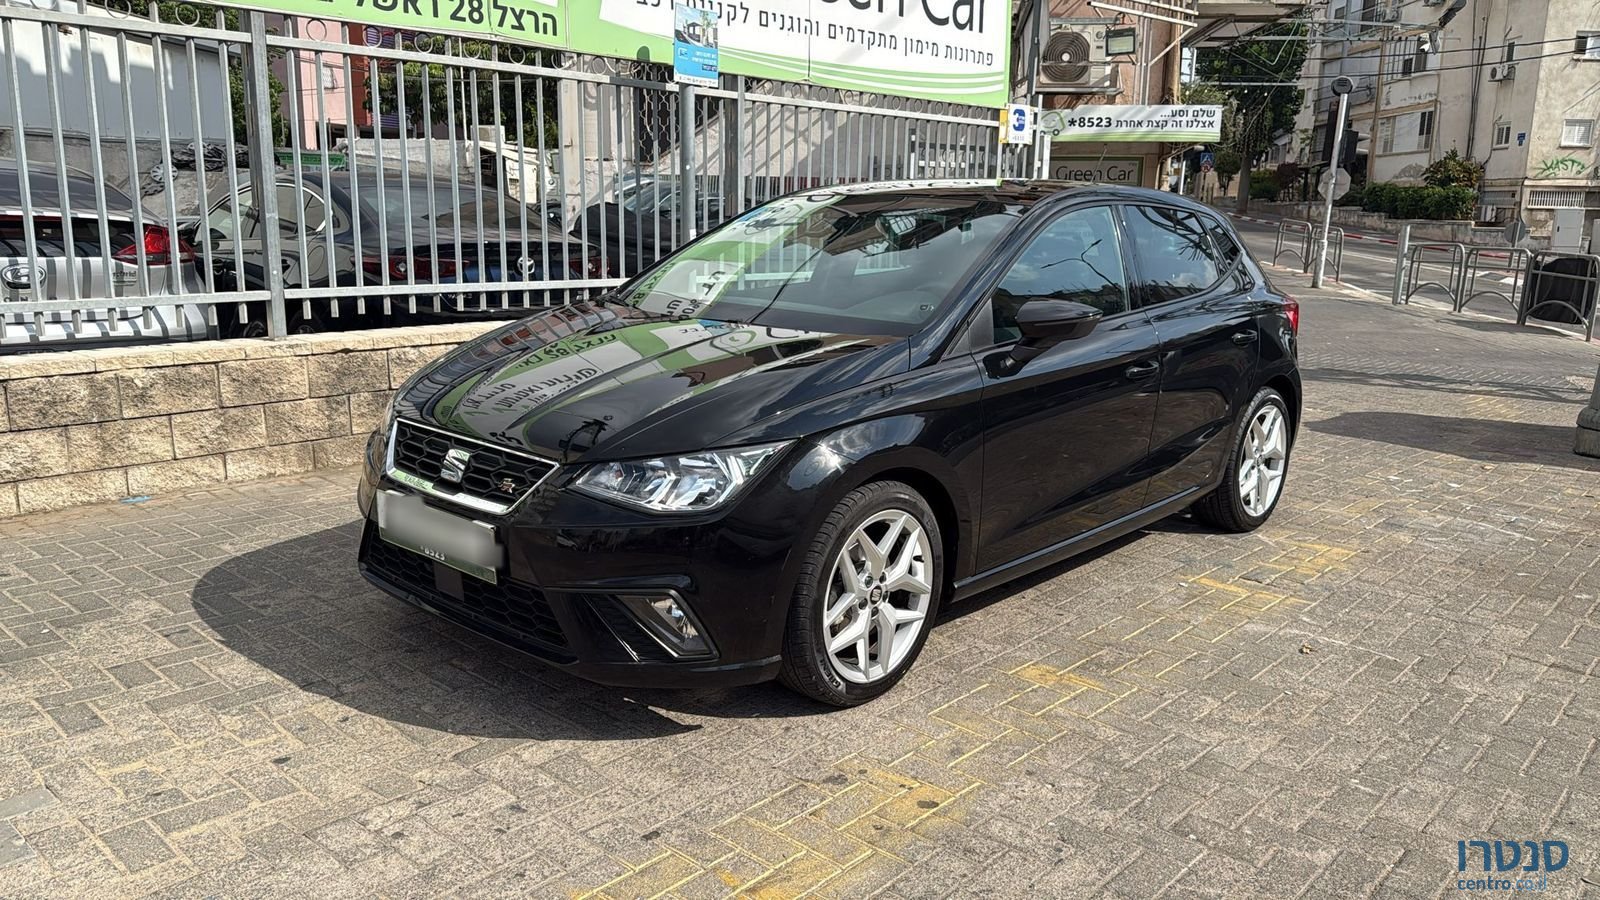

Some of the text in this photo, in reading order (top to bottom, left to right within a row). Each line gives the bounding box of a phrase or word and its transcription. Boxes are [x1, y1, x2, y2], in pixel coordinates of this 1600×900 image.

[449, 0, 485, 25] 28
[494, 1, 558, 37] הרצל
[758, 10, 820, 37] והוגנים
[828, 23, 898, 51] מתקדמים
[903, 36, 939, 57] מימון
[944, 44, 994, 67] פתרונות
[1191, 108, 1216, 118] שלם
[1115, 119, 1144, 128] אחרת
[1146, 119, 1169, 130] קצת
[1171, 119, 1183, 128] זה
[1185, 118, 1215, 128] אצלנו
[1055, 165, 1134, 181] Green Car
